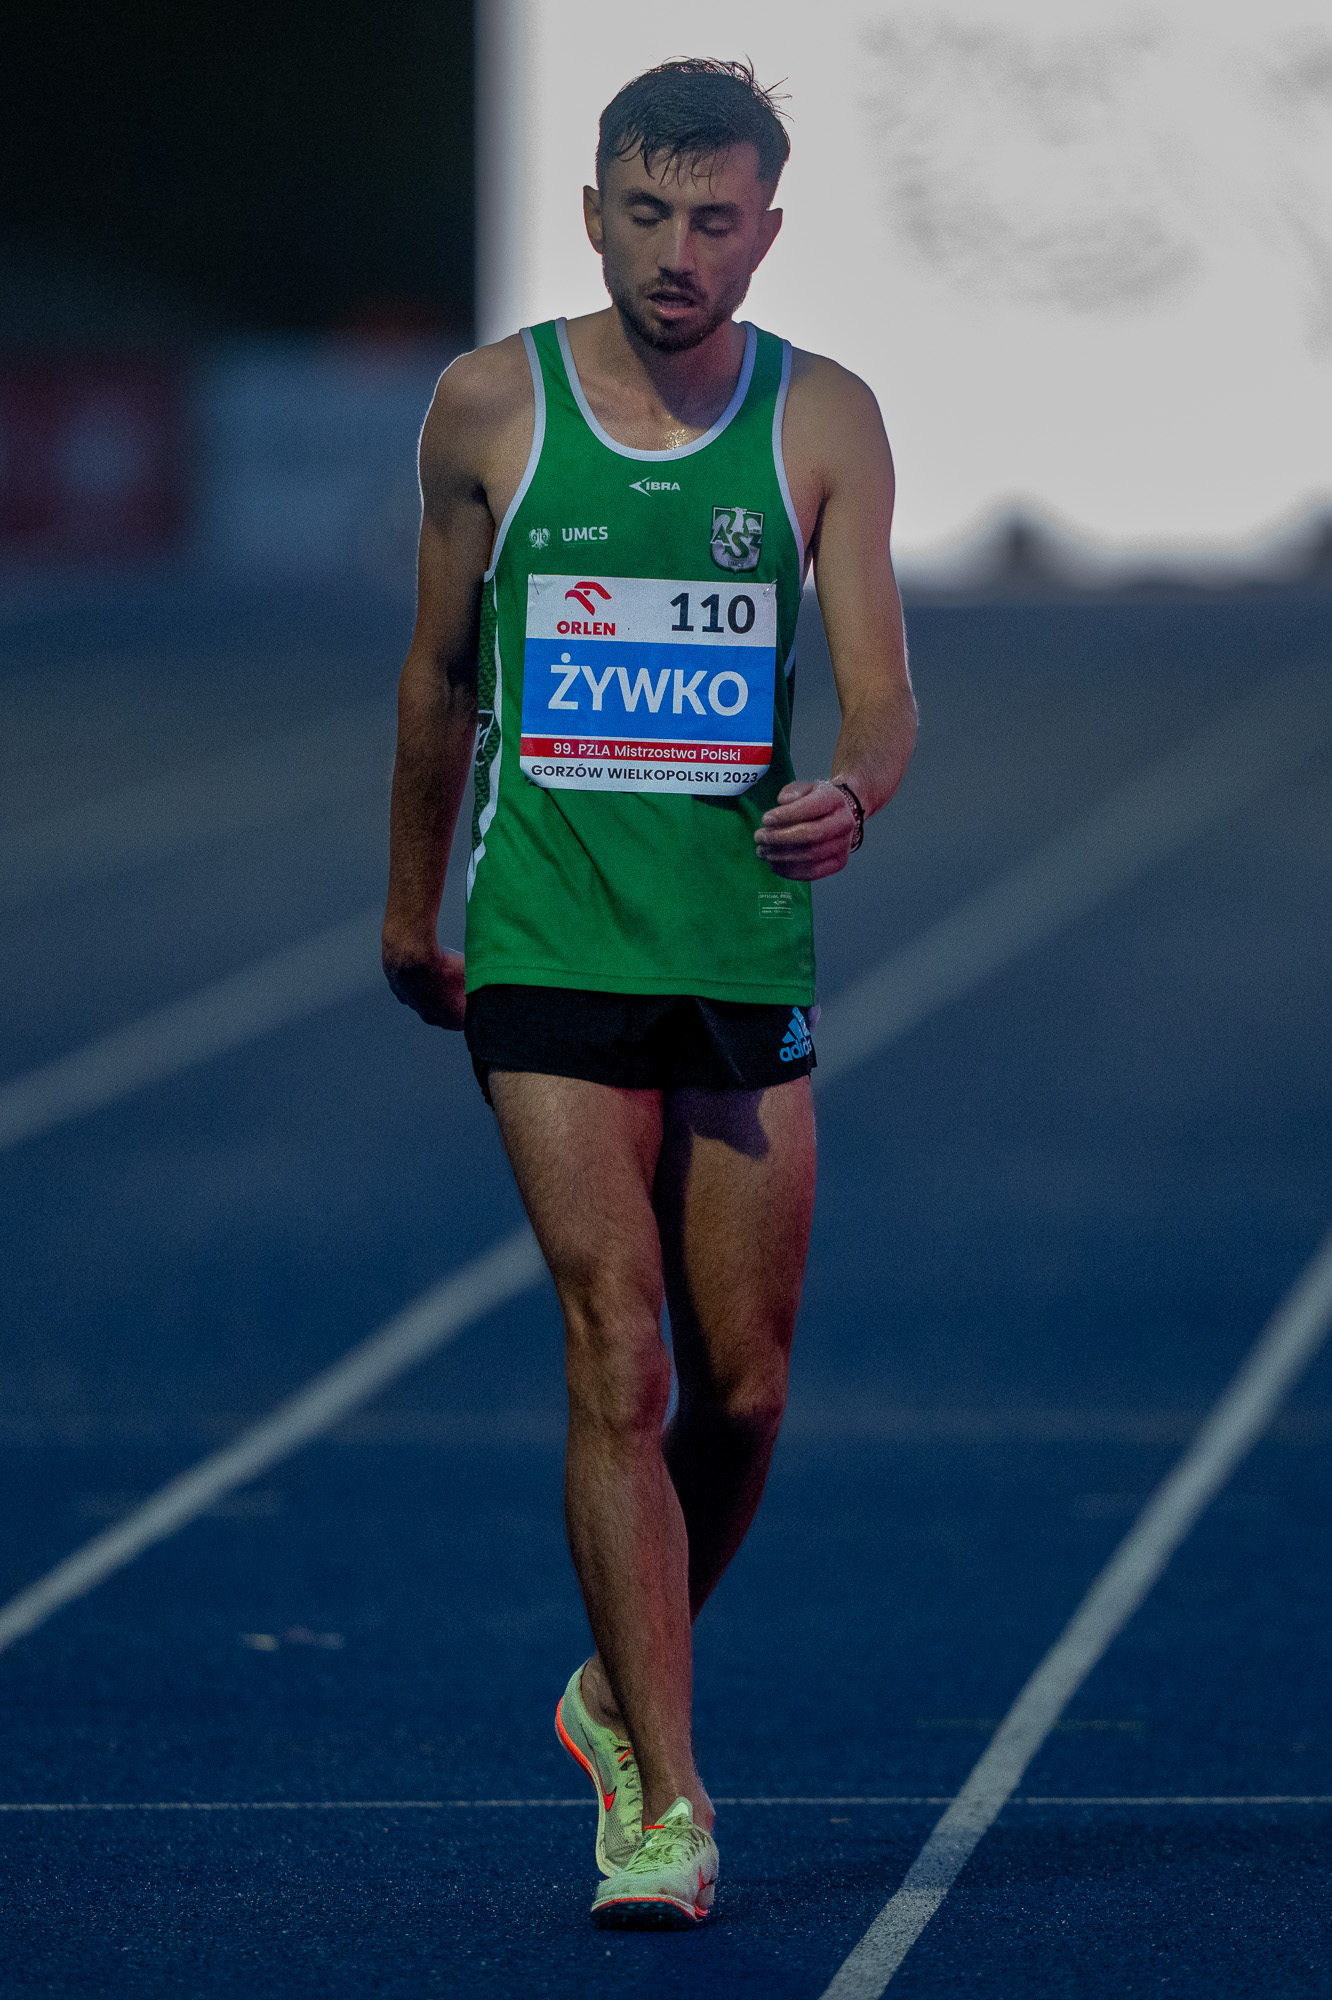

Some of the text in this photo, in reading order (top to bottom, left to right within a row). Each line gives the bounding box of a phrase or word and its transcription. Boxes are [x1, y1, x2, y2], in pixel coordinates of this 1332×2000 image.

[646, 481, 681, 491] IBRA
[561, 526, 609, 542] UMCS
[670, 592, 756, 634] 110
[557, 621, 616, 636] ORLEN
[548, 652, 749, 717] ŻYWKO
[553, 742, 741, 761] 99. PZLA Mistrzostwa Polski
[531, 763, 759, 784] GORZÓW WIELKOPOLSKI 2023
